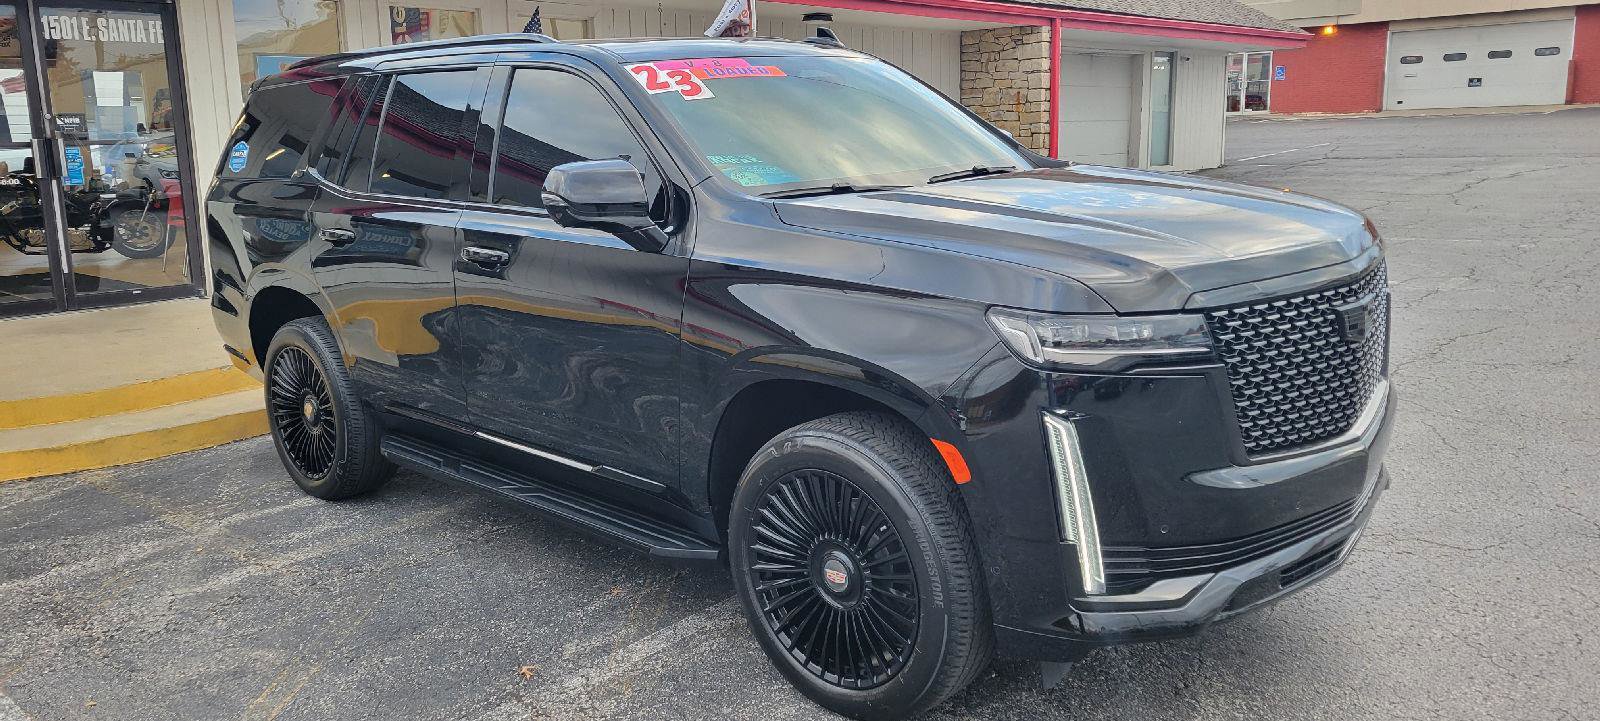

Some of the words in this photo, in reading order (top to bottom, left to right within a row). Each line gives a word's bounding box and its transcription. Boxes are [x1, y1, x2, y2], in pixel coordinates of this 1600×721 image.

[41, 15, 80, 40] 1501
[80, 17, 96, 41] E.
[97, 17, 147, 42] SANTA
[148, 20, 164, 44] FE
[631, 65, 702, 97] 23
[703, 66, 769, 78] LOADED
